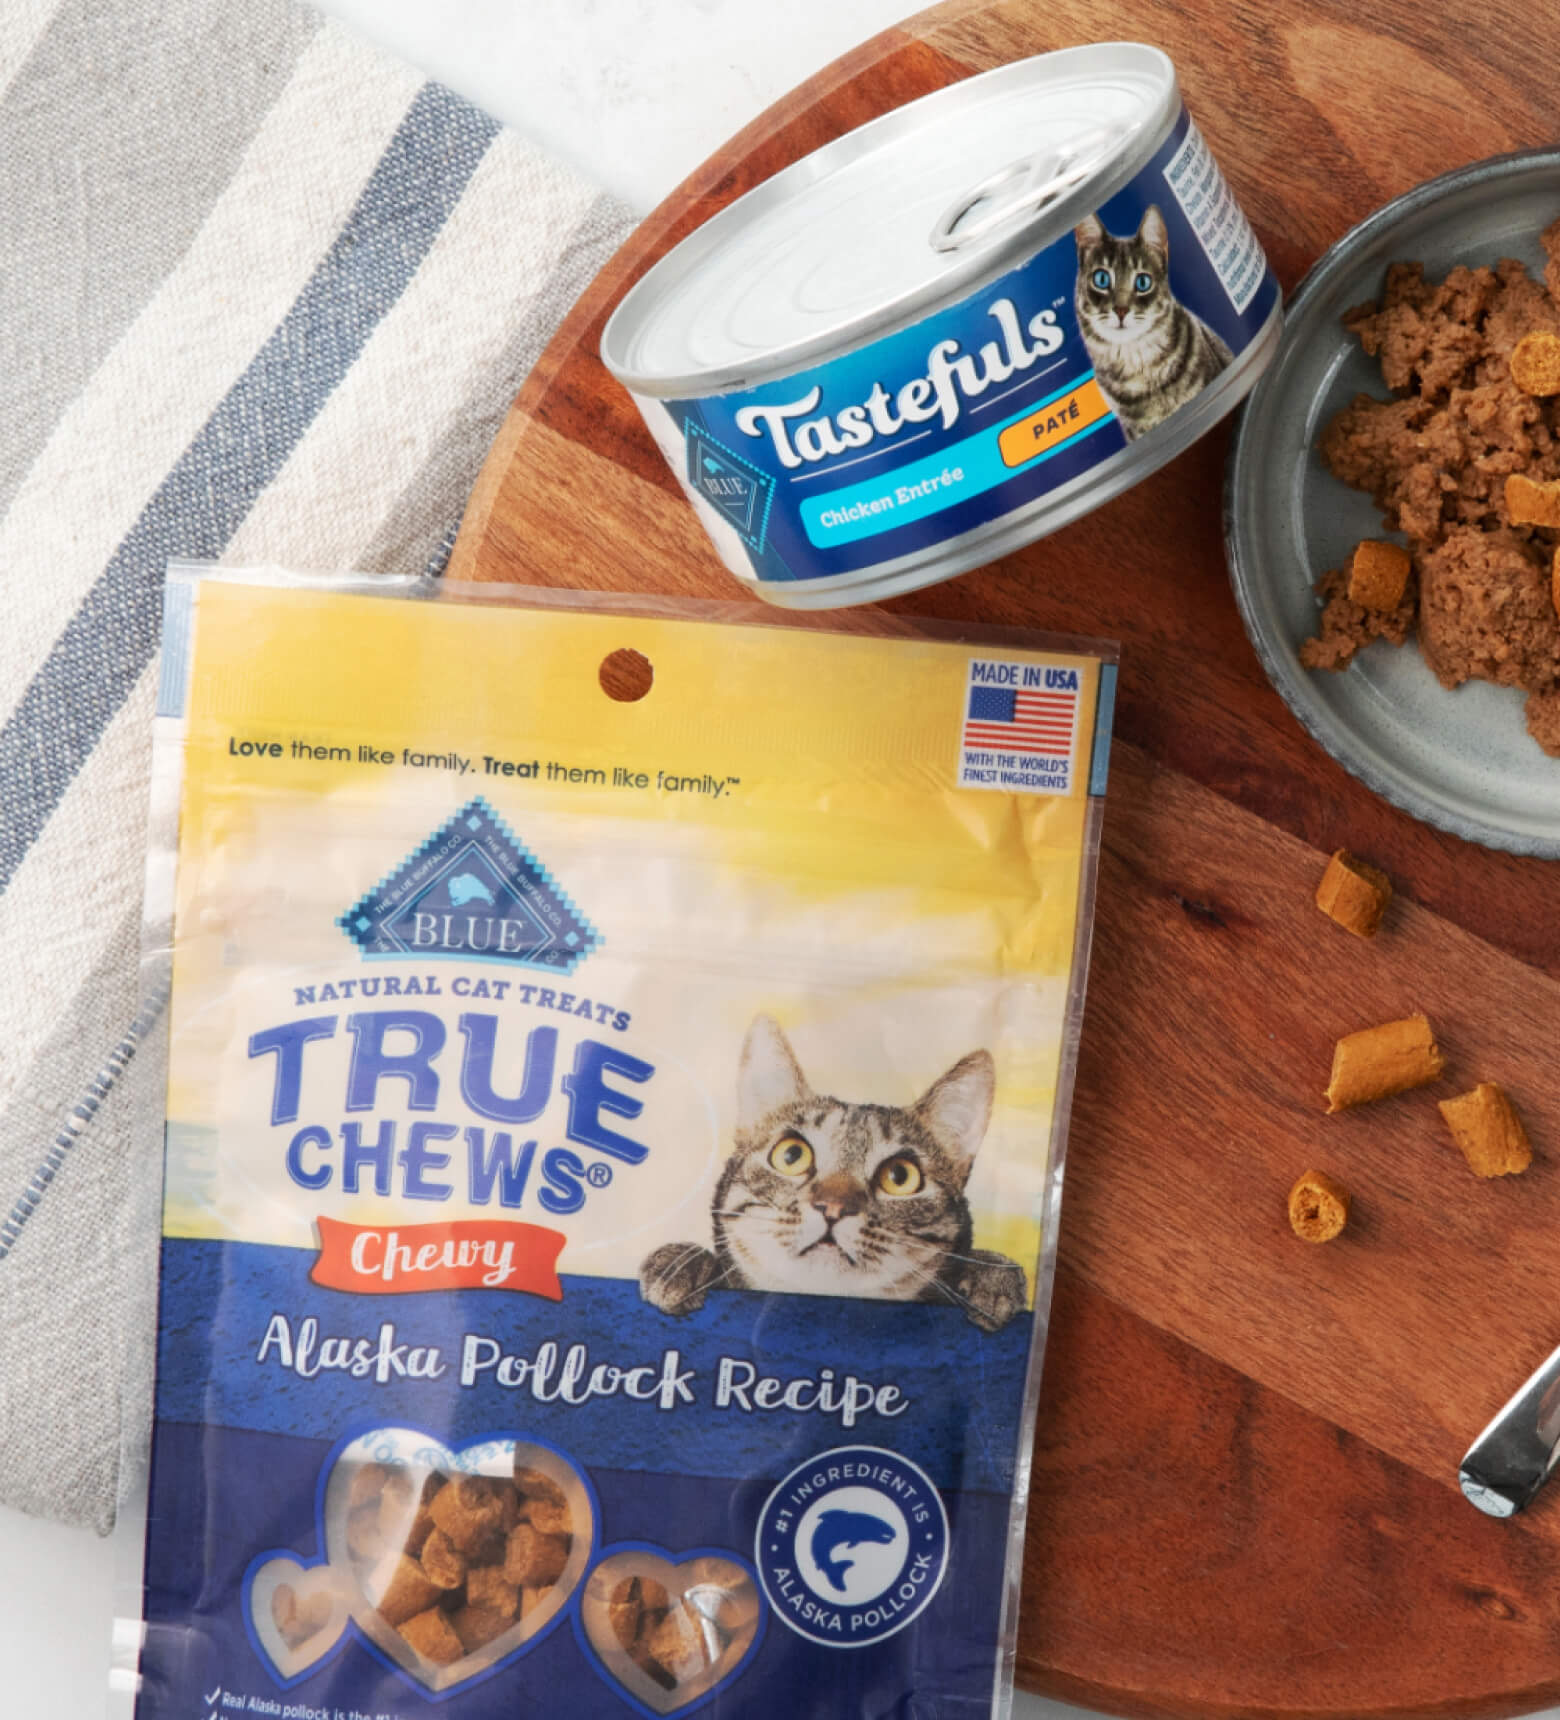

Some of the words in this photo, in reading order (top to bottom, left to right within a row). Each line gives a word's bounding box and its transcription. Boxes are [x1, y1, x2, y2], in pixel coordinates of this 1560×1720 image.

[1033, 399, 1080, 441] PATÉ
[704, 477, 748, 497] BLUE
[820, 494, 894, 529] Chicken
[895, 467, 965, 504] Entrée
[971, 662, 1019, 685] MADE
[1023, 667, 1041, 686] IN
[1045, 669, 1079, 691] USA
[228, 737, 283, 757] Love
[291, 740, 351, 761] them
[358, 745, 395, 765] like
[402, 748, 476, 776] family.
[483, 756, 540, 779] Treat
[546, 762, 606, 785] them
[613, 767, 650, 788] like
[963, 768, 997, 783] FINEST
[1000, 771, 1068, 789] INGREDIENTS
[964, 752, 994, 766] WITH
[997, 755, 1016, 769] THE
[1019, 756, 1069, 774] WORLD'S
[483, 834, 501, 854] THE
[374, 897, 393, 915] THE
[413, 912, 524, 953] BLUE
[293, 975, 442, 1005] NATURAL
[451, 977, 510, 1000] CAT
[519, 984, 632, 1032] TREATS
[248, 1010, 656, 1166] TRUE
[351, 1233, 517, 1285] Chewy
[257, 1315, 445, 1382] Alaska
[461, 1334, 695, 1409] Pollock
[715, 1357, 909, 1427] Recipe
[775, 1509, 793, 1533] #1
[791, 1464, 918, 1505] INGREDIENT
[911, 1502, 930, 1523] IS
[773, 1568, 842, 1631] ALASKA
[851, 1552, 932, 1631] POLLOCK
[222, 1691, 245, 1708] Real
[247, 1696, 281, 1713] Alaska
[282, 1703, 329, 1719] pollock
